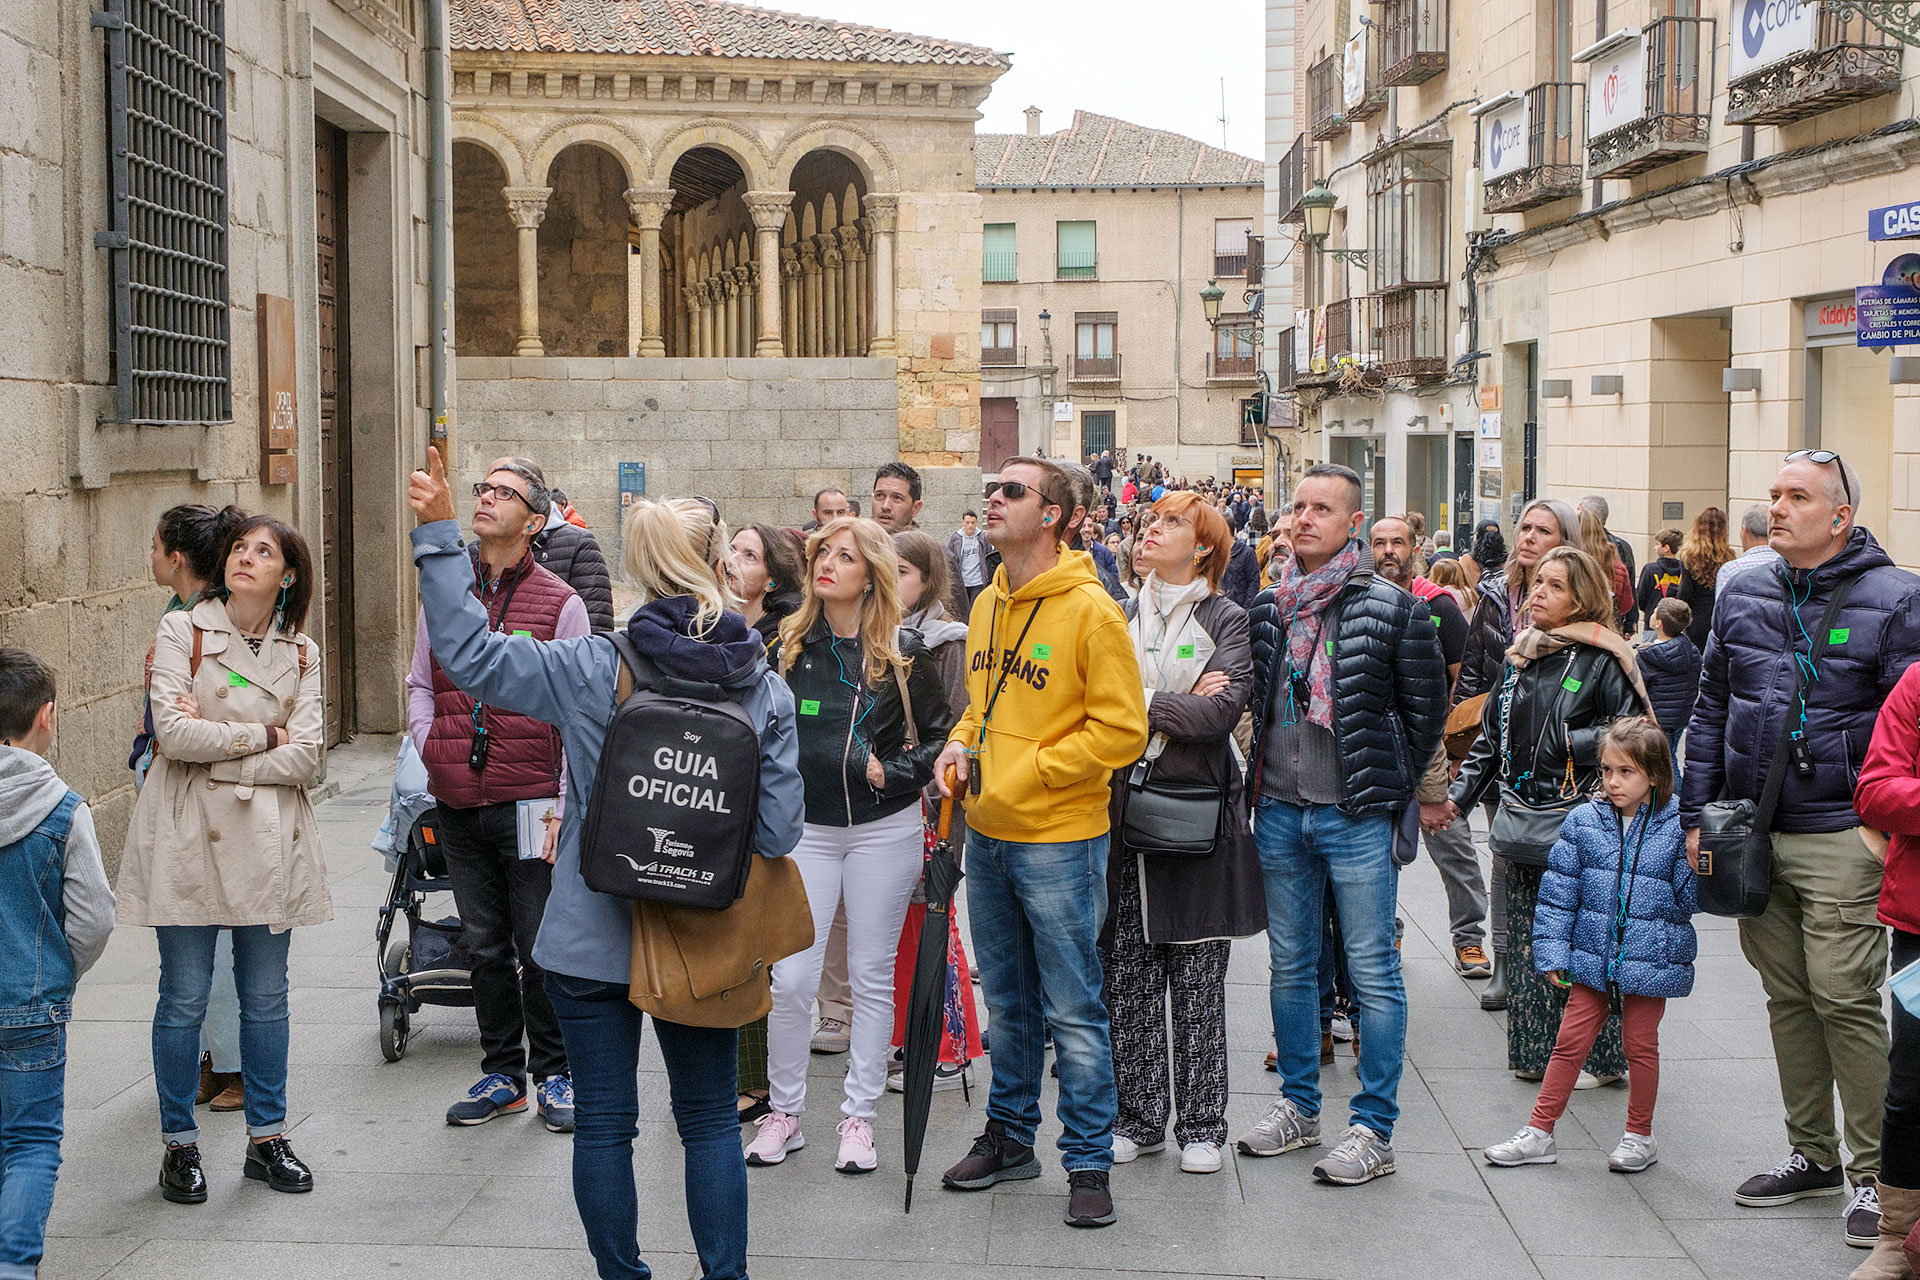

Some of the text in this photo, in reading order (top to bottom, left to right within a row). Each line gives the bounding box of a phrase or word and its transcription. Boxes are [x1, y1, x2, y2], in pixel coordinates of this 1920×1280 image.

[1766, 0, 1801, 31] COPE
[1502, 125, 1520, 151] COPE
[1819, 304, 1856, 327] Kiddy's
[1863, 309, 1889, 317] TARJETAS
[1869, 320, 1897, 328] CRISTALES
[1861, 330, 1890, 340] CAMBIO
[1892, 330, 1902, 338] DE
[683, 731, 702, 744] Soy
[653, 747, 718, 780] GUIA
[628, 775, 731, 814] OFICIAL
[664, 839, 688, 849] Turismo
[662, 845, 694, 858] Segovia
[659, 864, 715, 881] TRACK 13
[637, 877, 687, 889] www.track13.com
